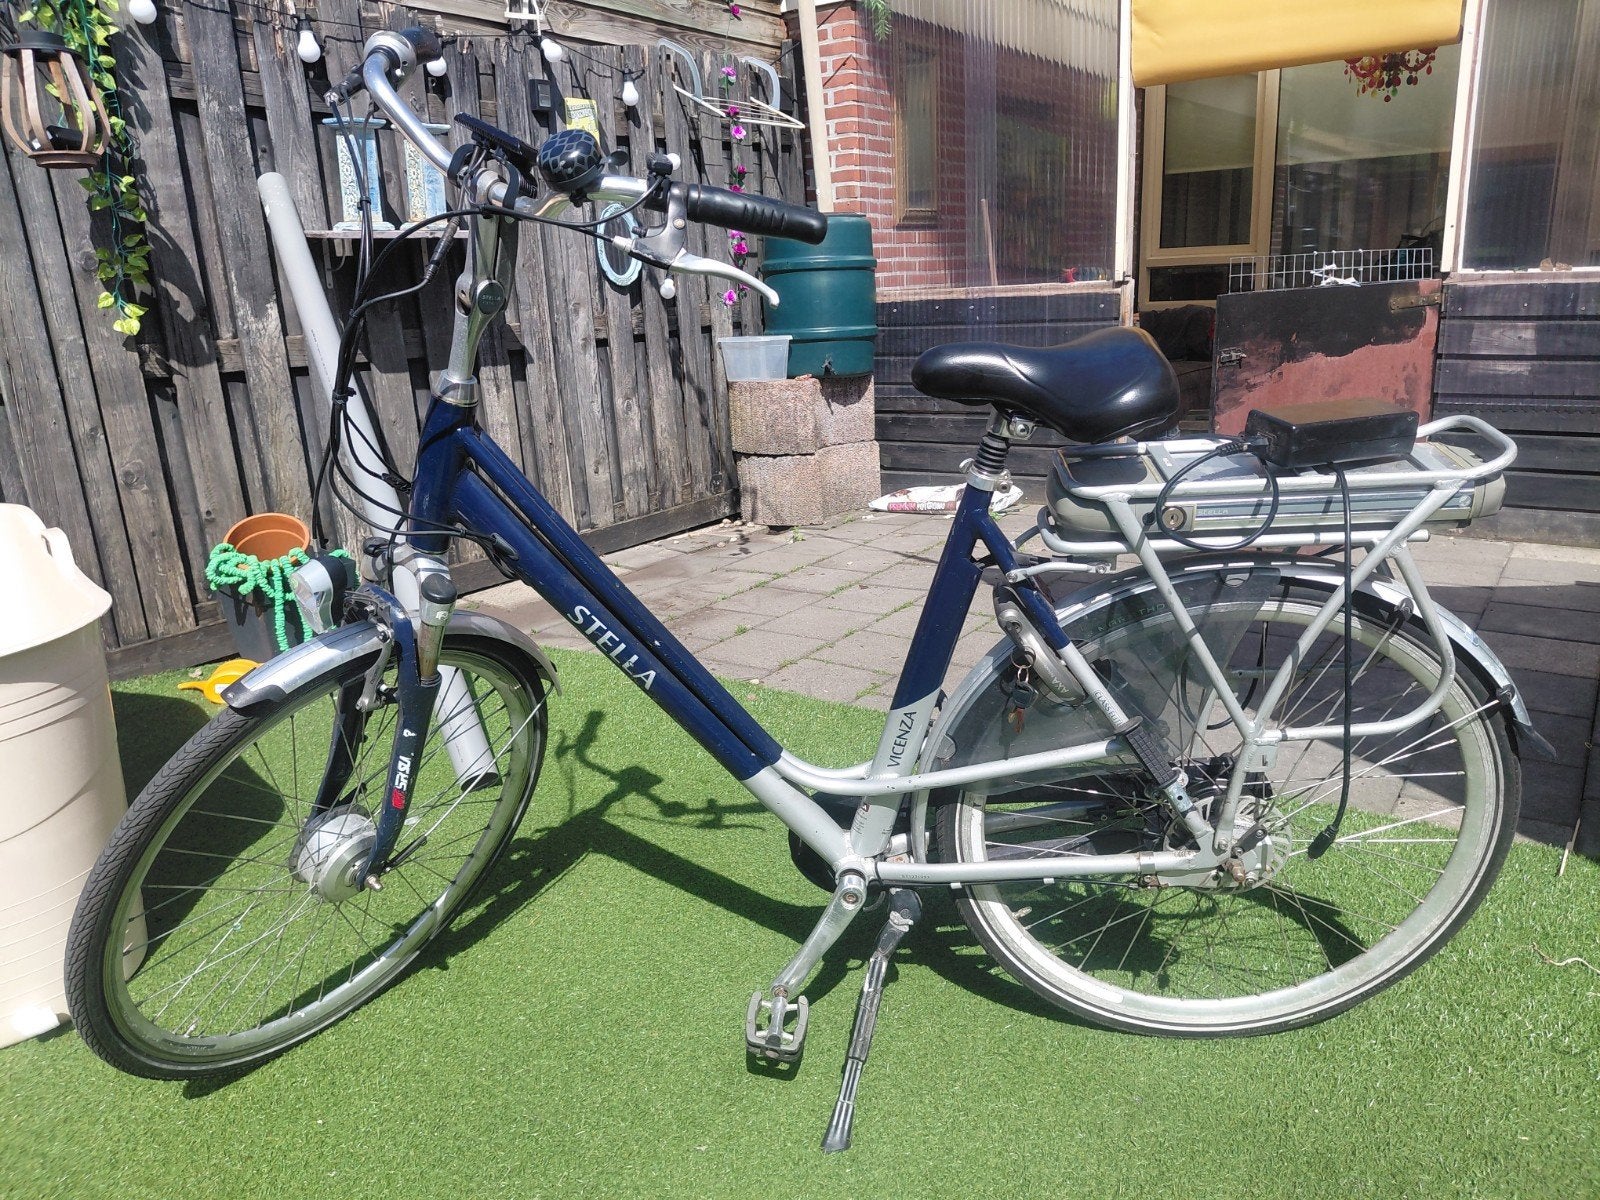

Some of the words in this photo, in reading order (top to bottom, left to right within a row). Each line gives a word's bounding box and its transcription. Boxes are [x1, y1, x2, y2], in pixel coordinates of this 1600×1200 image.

[567, 605, 656, 691] STELLA
[1052, 677, 1069, 693] AXA
[887, 711, 917, 767] VICENZA
